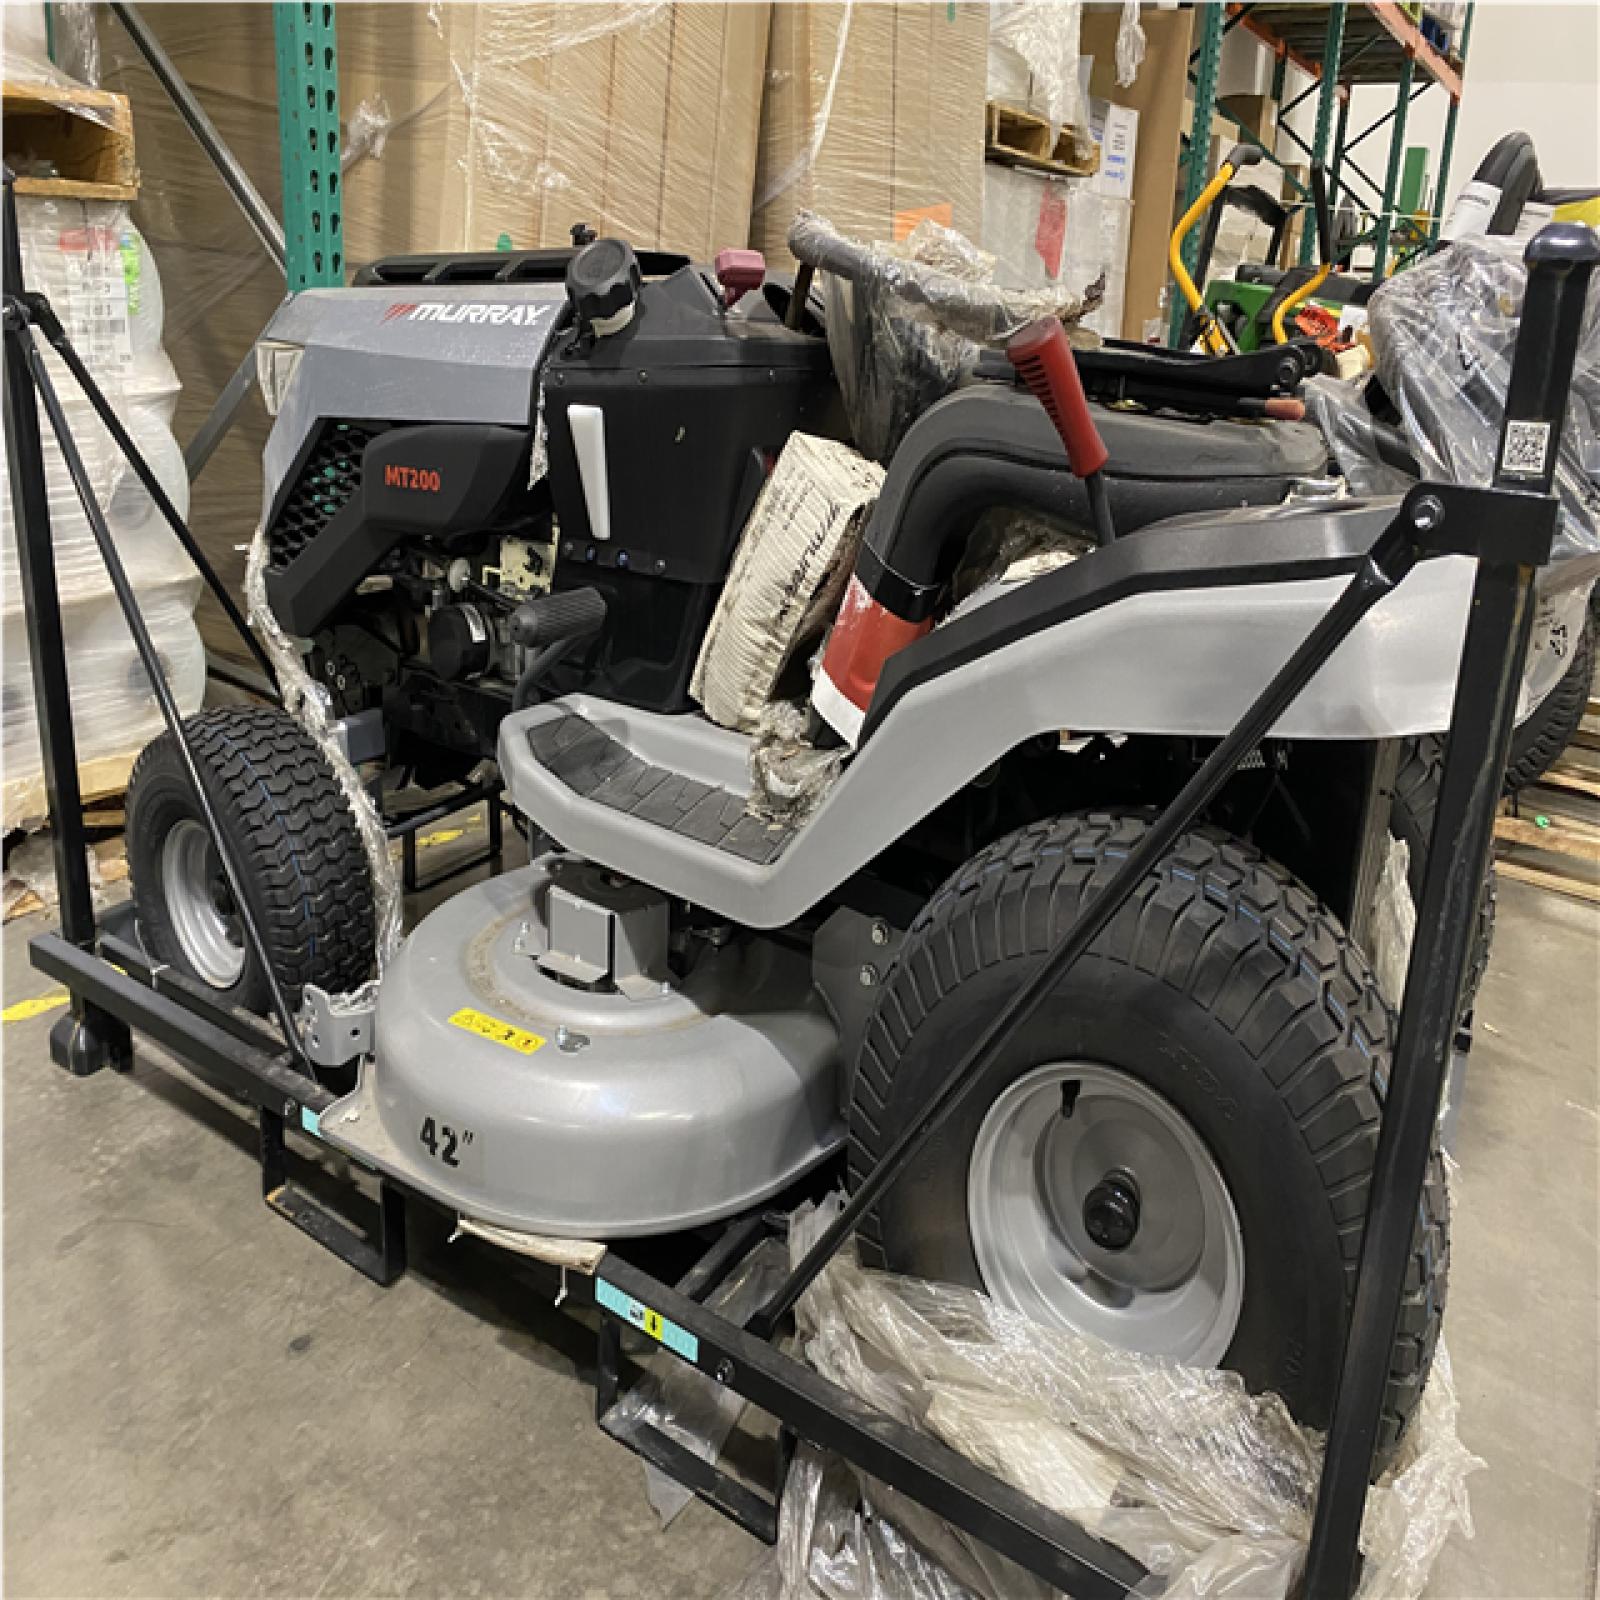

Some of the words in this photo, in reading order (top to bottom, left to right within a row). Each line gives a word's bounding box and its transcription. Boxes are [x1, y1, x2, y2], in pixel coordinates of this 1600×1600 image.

[407, 304, 551, 326] MURRAY
[384, 464, 441, 493] MT200
[419, 1116, 474, 1168] 42"
